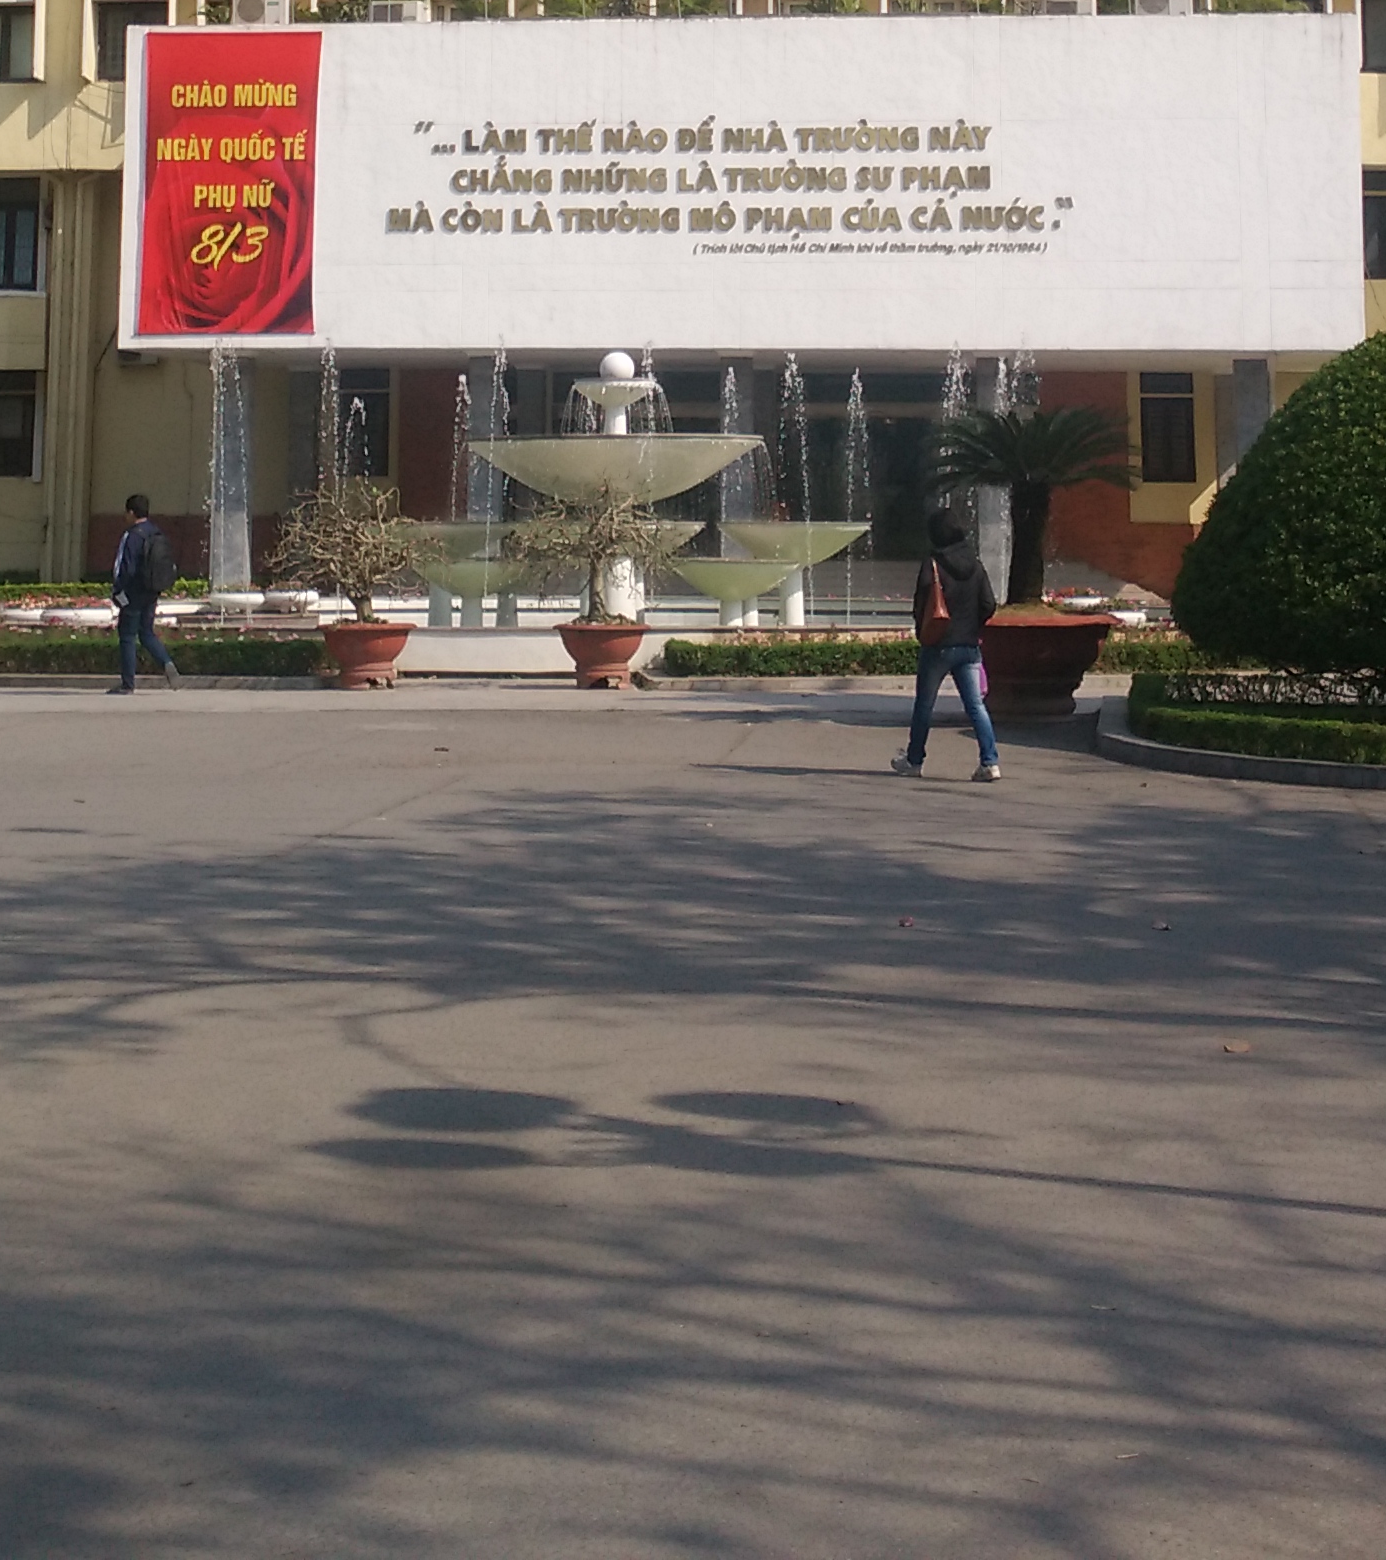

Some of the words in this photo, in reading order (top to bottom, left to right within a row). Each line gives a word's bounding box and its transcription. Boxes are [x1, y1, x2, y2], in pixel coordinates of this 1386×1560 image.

[171, 79, 228, 108] CHÀO
[233, 78, 298, 107] MỪNG
[156, 132, 213, 161] NGÀY
[219, 129, 276, 163] QUỐC
[281, 128, 308, 161] TẾ
[535, 118, 597, 154] THẾ
[600, 120, 669, 154] NÀO
[721, 119, 788, 153] NHÀ
[793, 118, 920, 153] TRƯỜNG
[927, 118, 993, 152] NÀY
[450, 154, 553, 195] CHẲNG
[560, 160, 668, 195] NHỮNG
[675, 160, 719, 193] LÀ
[721, 158, 848, 193] TRƯỜNG
[854, 166, 895, 192] SƯ
[901, 165, 992, 200] PHẠM
[193, 184, 236, 213] PHỤ
[241, 178, 275, 208] NỮ
[385, 200, 435, 235] MÀ
[439, 200, 504, 235] CÒN
[510, 200, 553, 234] LÀ
[557, 200, 681, 235] TRƯỜNG
[688, 200, 736, 233] MÔ
[744, 207, 833, 241] PHẠM
[841, 197, 903, 233] CỦA
[908, 197, 953, 233] CẢ
[190, 221, 269, 272] 8/3
